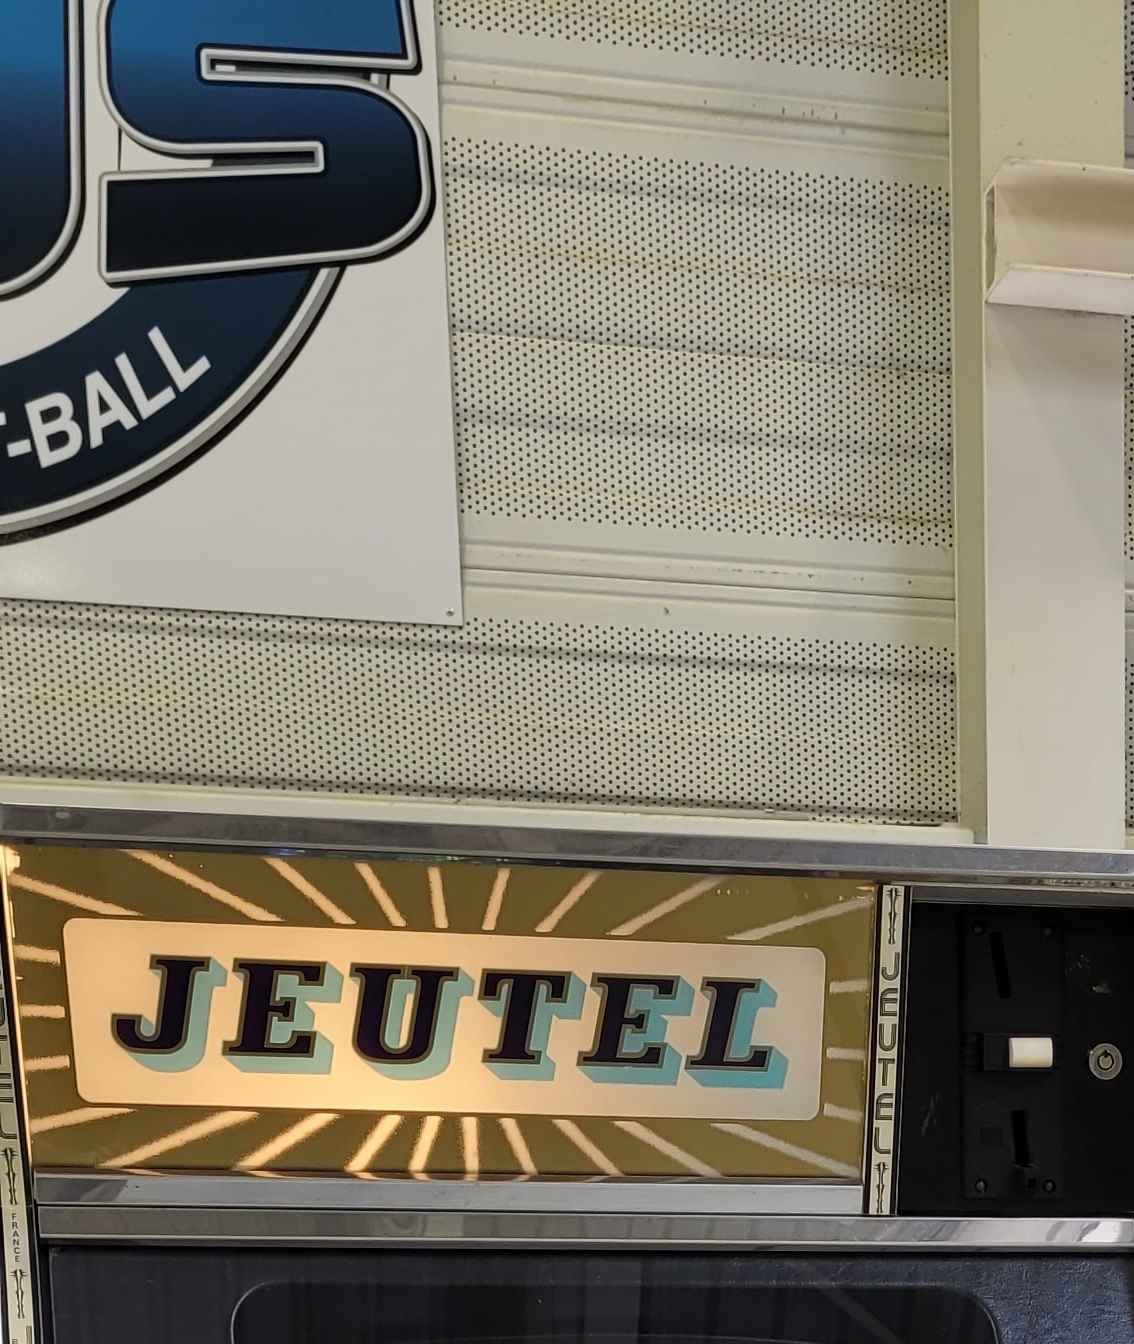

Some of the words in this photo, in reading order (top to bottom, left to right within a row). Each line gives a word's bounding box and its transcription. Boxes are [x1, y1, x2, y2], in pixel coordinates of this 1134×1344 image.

[0, 326, 211, 469] -BALL
[110, 952, 787, 1091] JEUTEL
[873, 951, 900, 1155] JEUTEL
[11, 1213, 21, 1263] FRANCE
